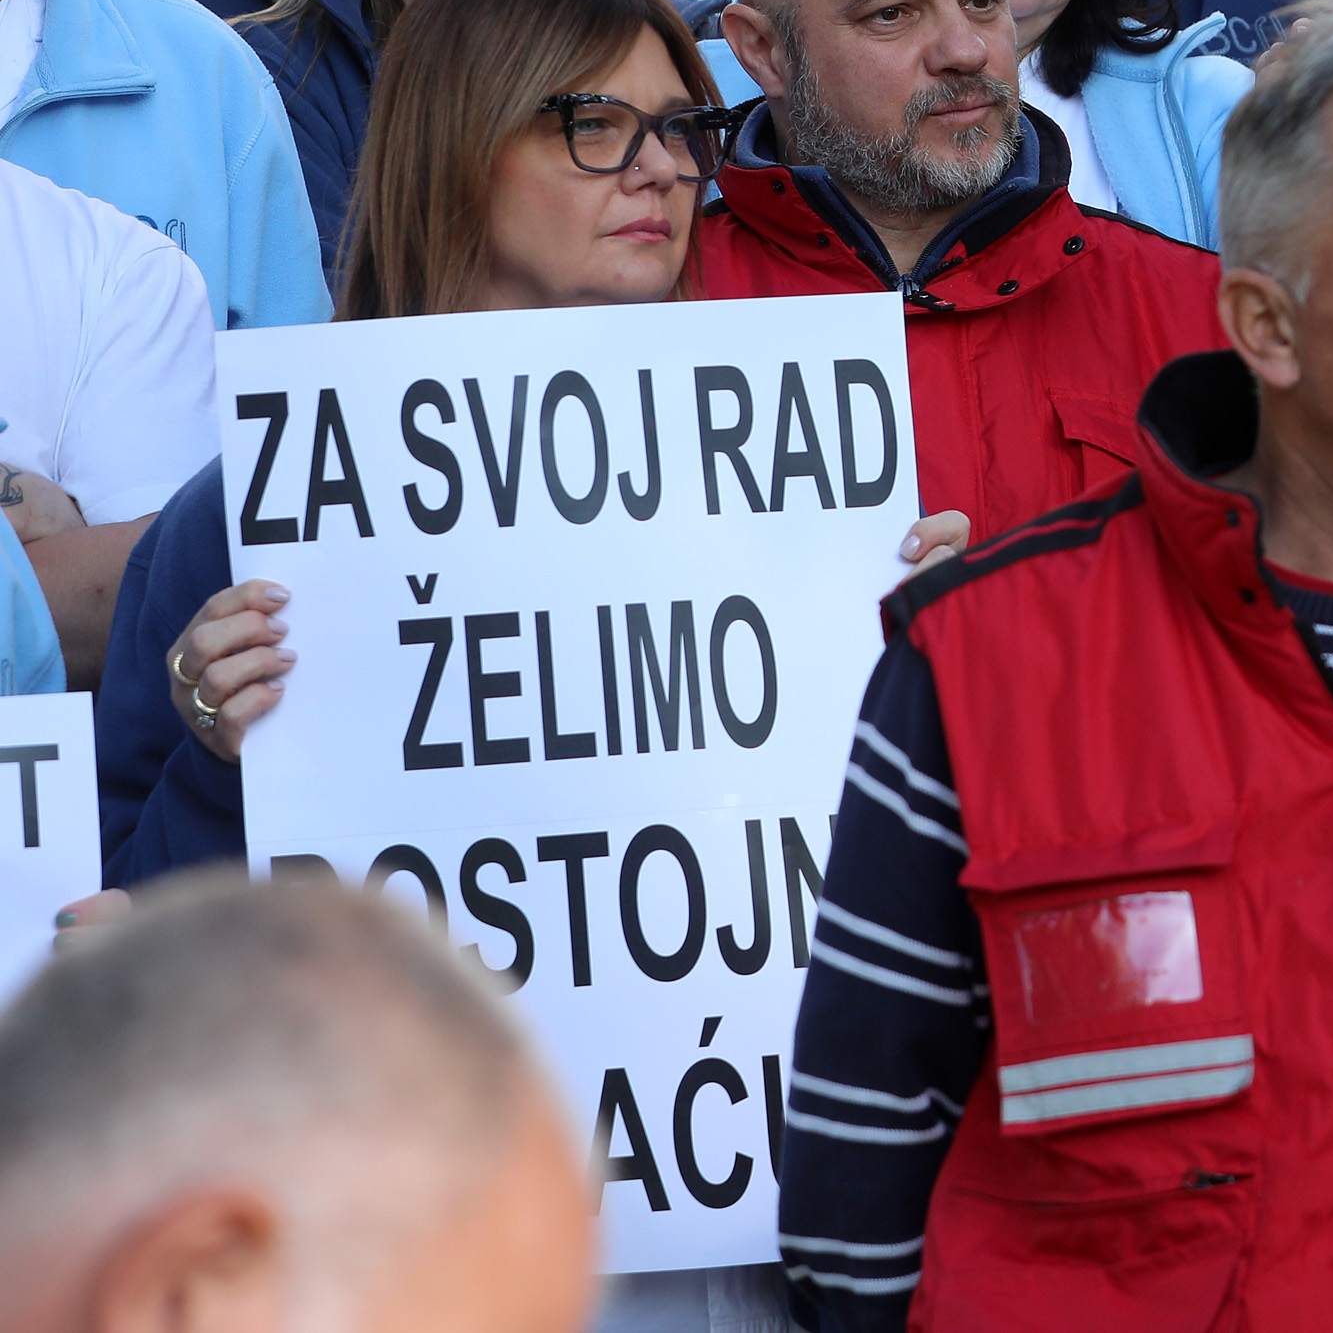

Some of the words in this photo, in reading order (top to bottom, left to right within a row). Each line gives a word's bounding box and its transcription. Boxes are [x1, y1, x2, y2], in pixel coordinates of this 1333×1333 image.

[235, 387, 375, 546] ZA
[400, 369, 663, 535] SVOJ
[694, 357, 899, 516] RAD
[398, 573, 778, 771] ŽELIMO
